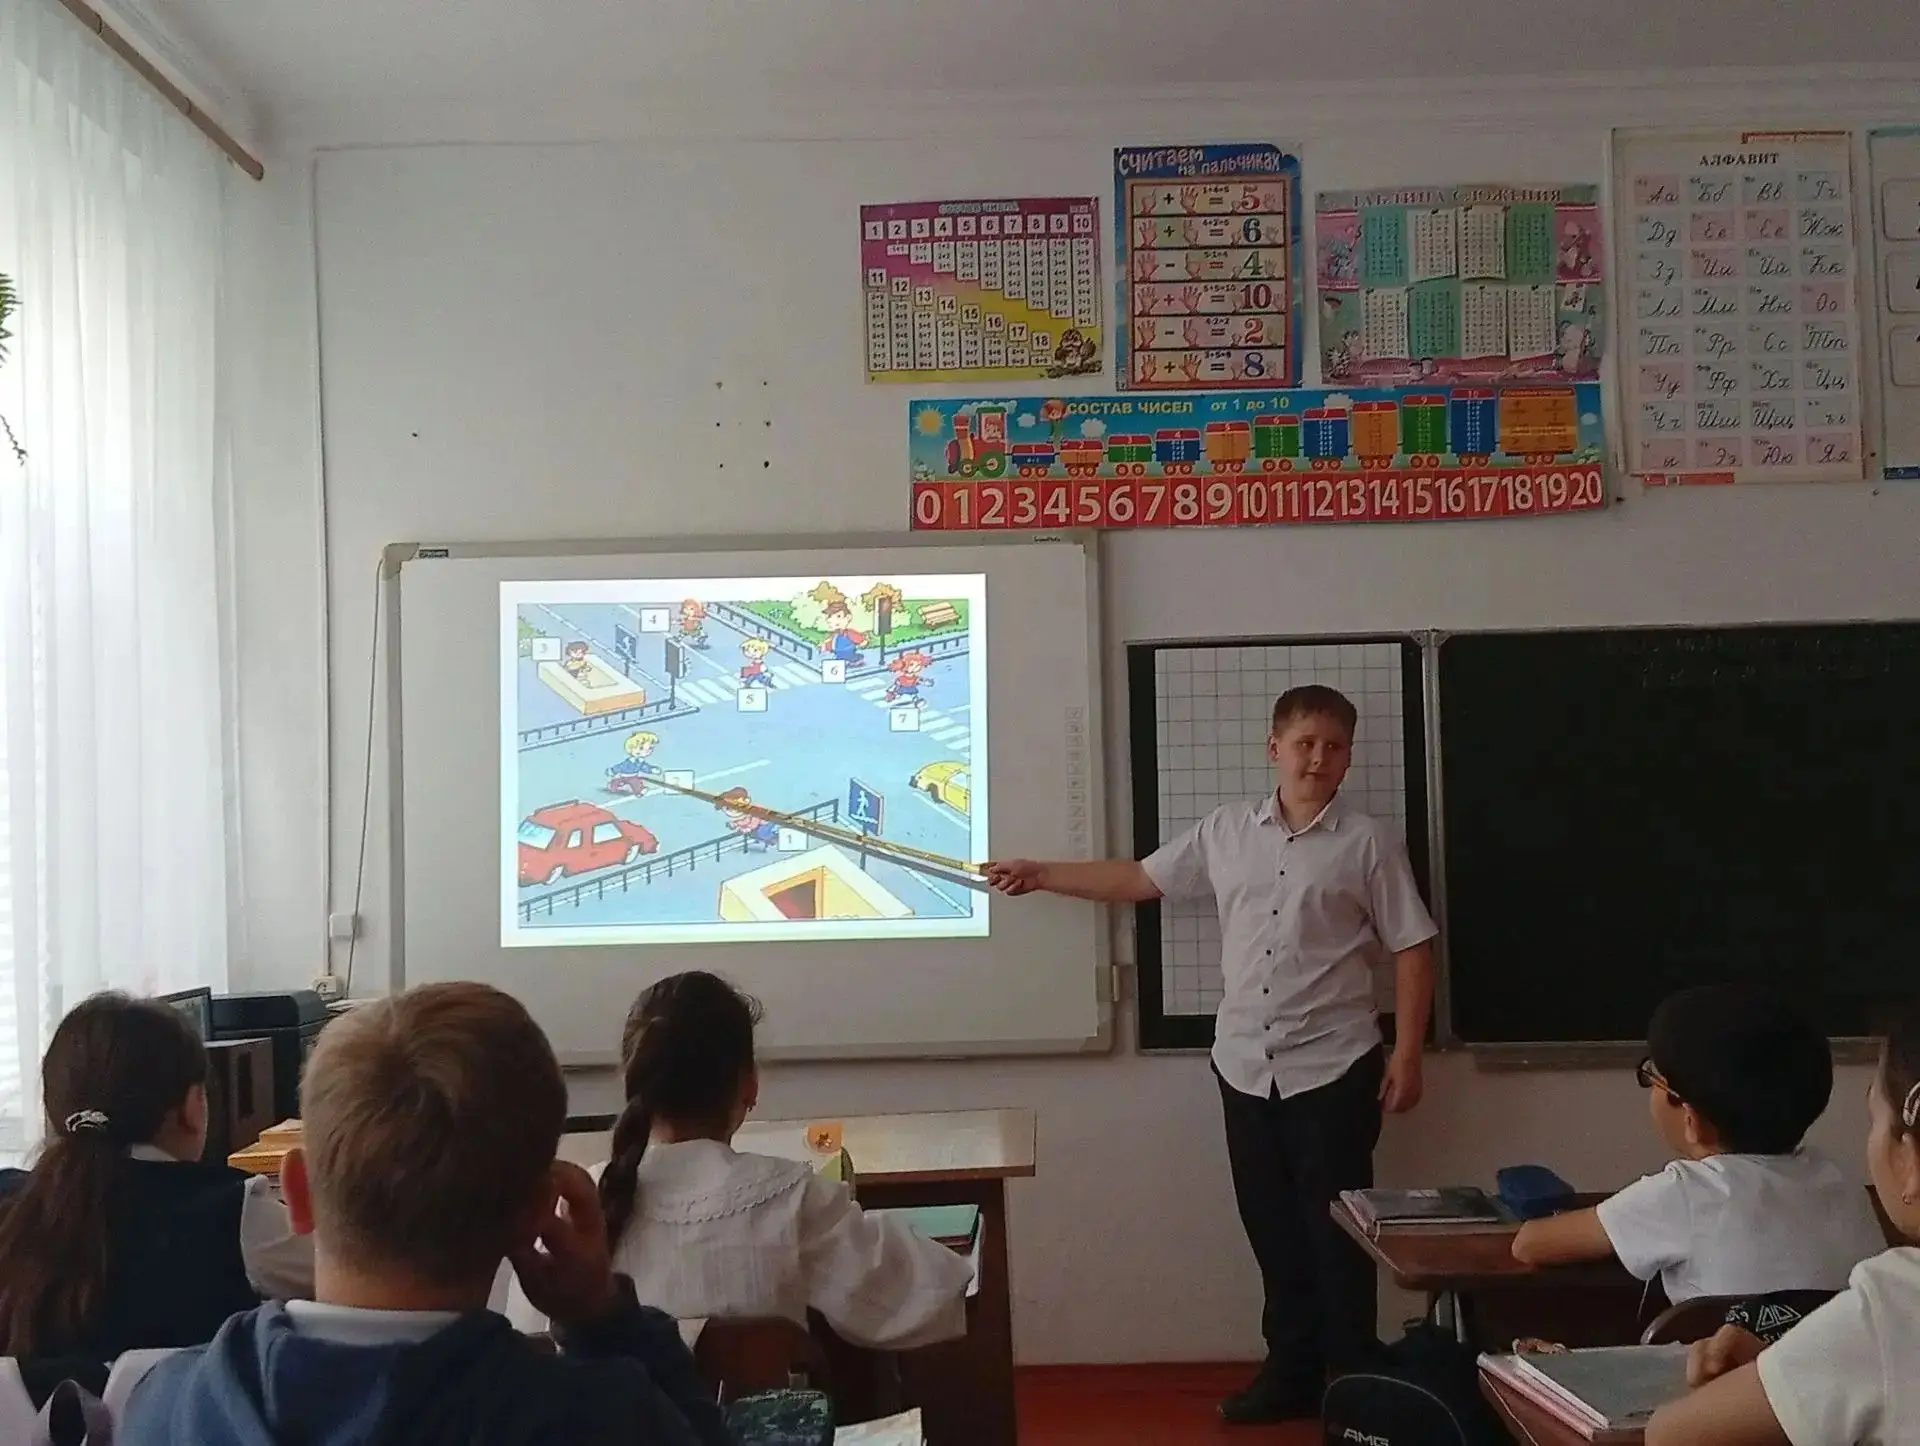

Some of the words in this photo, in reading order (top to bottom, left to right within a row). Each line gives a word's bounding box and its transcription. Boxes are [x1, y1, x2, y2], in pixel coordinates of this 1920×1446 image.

[1177, 163, 1196, 176] на
[1201, 151, 1282, 175] пальчиках
[1699, 153, 1780, 168] АЛФАВИТ
[1240, 185, 1261, 211] 5
[1647, 184, 1680, 203] Аа
[1696, 182, 1733, 203] Бб
[1755, 182, 1784, 200] Вв
[894, 224, 901, 235] 2
[917, 222, 924, 233] 3
[939, 221, 947, 232] 4
[963, 220, 970, 231] 5
[986, 220, 993, 231] 6
[1010, 219, 1017, 230] 7
[1033, 218, 1040, 229] 8
[1056, 218, 1063, 229] 9
[1076, 217, 1089, 228] 10
[1243, 217, 1262, 243] 6
[1646, 221, 1677, 248] Дд
[1704, 221, 1728, 239] Ее
[1800, 216, 1844, 238] Жж
[1242, 250, 1263, 276] 4
[1808, 255, 1846, 275] Кк
[872, 272, 884, 283] 11
[1650, 260, 1675, 287] Зз
[895, 281, 908, 292] 12
[918, 290, 931, 302] 13
[941, 299, 954, 310] 14
[1240, 283, 1272, 310] 10
[1759, 295, 1792, 313] Нн
[1816, 292, 1838, 312] Оо
[965, 308, 978, 320] 15
[1647, 298, 1681, 317] Лл
[1693, 297, 1738, 315] Мм
[987, 316, 1001, 328] 16
[1244, 318, 1264, 344] 2
[1011, 326, 1025, 337] 17
[1035, 335, 1048, 346] 18
[1646, 334, 1681, 355] Пп
[1706, 332, 1736, 360] Рр
[1763, 332, 1787, 352] Сс
[1806, 331, 1848, 351] Тт
[1244, 352, 1264, 378] 8
[1655, 372, 1680, 401] Уу
[1760, 370, 1792, 389] Хх
[1816, 369, 1848, 391] Цц
[1420, 396, 1427, 404] 9
[1468, 390, 1478, 398] 10
[1067, 401, 1132, 415] СОСТАВ
[1138, 401, 1193, 414] ЧИСЕЛ
[1211, 401, 1227, 411] от
[1232, 398, 1240, 410] 1
[1245, 400, 1265, 412] до
[1271, 397, 1290, 409] 10
[1323, 409, 1329, 418] 7
[1371, 403, 1378, 411] 8
[1272, 416, 1280, 424] 6
[1697, 409, 1740, 429] Шш
[1754, 408, 1795, 431] Щщ
[1126, 436, 1133, 444] 3
[1174, 430, 1181, 438] 4
[1079, 440, 1085, 448] 2
[1716, 448, 1738, 466] Ээ
[1761, 445, 1793, 464] Юю
[1817, 444, 1848, 464] Яя
[916, 490, 941, 525] 0
[953, 488, 970, 524] 1
[980, 487, 1006, 524] 2
[1013, 487, 1036, 524] 3
[1043, 487, 1070, 523] 4
[1077, 486, 1102, 522] 5
[1108, 485, 1134, 522] 6
[1141, 486, 1166, 521] 7
[1173, 483, 1200, 521] 8
[1206, 482, 1233, 520] 9
[1237, 481, 1268, 519] 10
[1271, 480, 1299, 518] 11
[1302, 480, 1334, 517] 12
[1335, 479, 1367, 516] 13
[1369, 479, 1400, 515] 14
[1402, 477, 1433, 514] 15
[1435, 476, 1466, 513] 16
[1468, 475, 1499, 512] 17
[1501, 474, 1534, 510] 18
[1535, 472, 1567, 508] 19
[1569, 471, 1602, 506] 20
[649, 614, 657, 625] 4
[539, 643, 548, 654] 3
[830, 666, 839, 675] 6
[746, 694, 755, 704] 5
[898, 714, 907, 723] 7
[787, 835, 792, 844] 1
[1343, 1428, 1390, 1446] AMG
